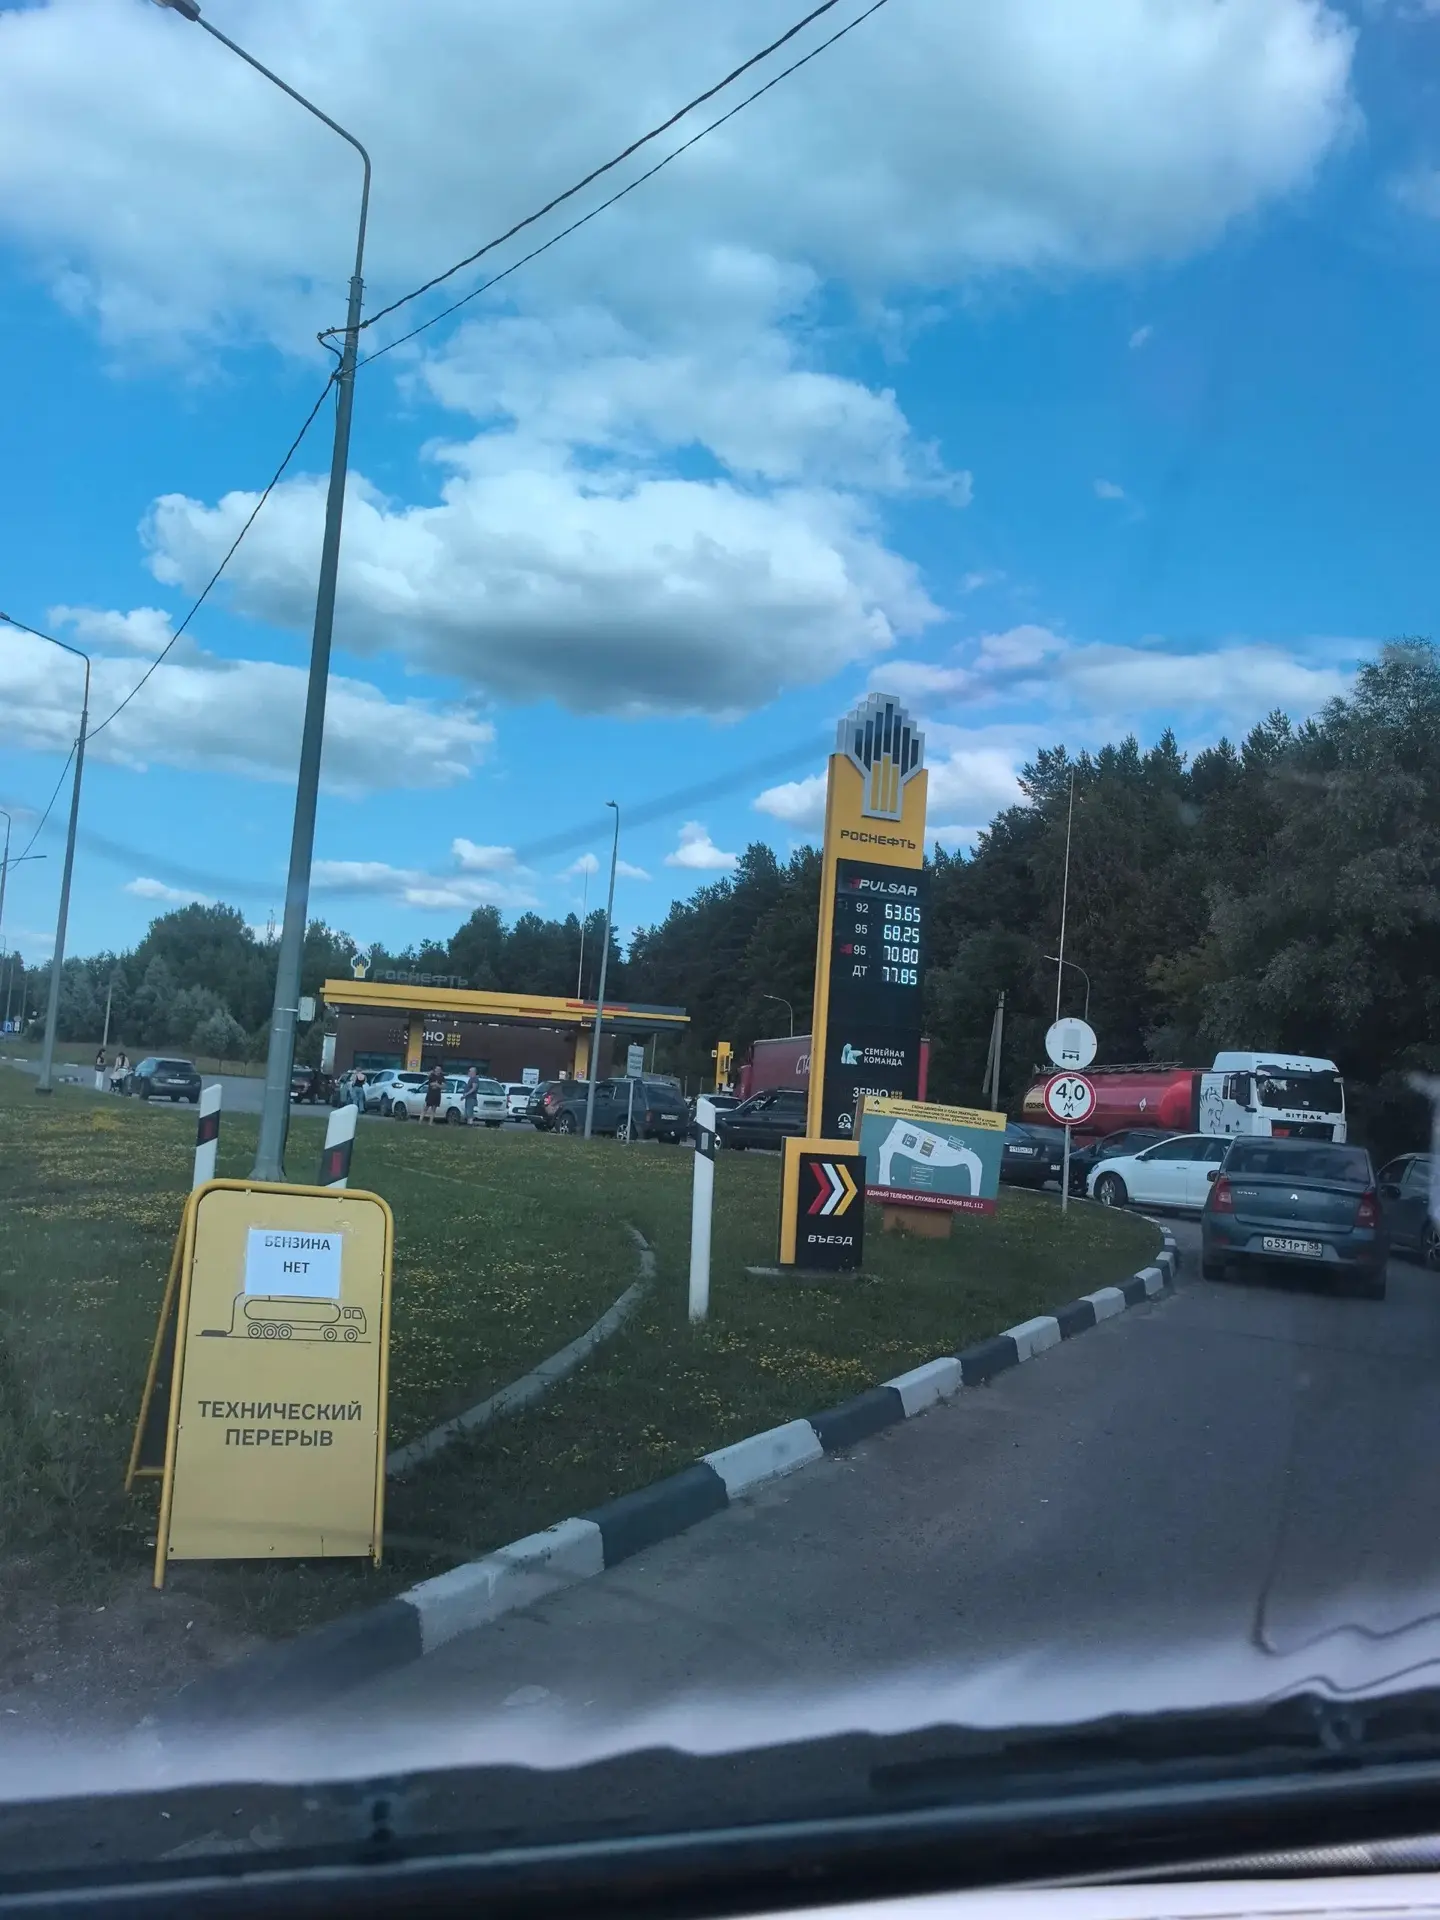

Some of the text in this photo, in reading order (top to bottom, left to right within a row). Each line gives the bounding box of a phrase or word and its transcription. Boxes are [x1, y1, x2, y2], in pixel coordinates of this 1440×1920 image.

[840, 829, 916, 850] РОСНЕФТЬ
[859, 879, 918, 897] PULSAR
[856, 902, 921, 923] 92 63.65
[855, 923, 920, 944] 95 68.25
[853, 944, 919, 965] 95 70.80
[374, 969, 469, 987] РОСНЕФТЬ
[852, 965, 917, 985] ДТ 77.85
[863, 1056, 903, 1067] КОМАНДА
[864, 1047, 905, 1058] СЕМЕЙНАЯ
[838, 1121, 852, 1129] 24
[1285, 1112, 1322, 1121] SITRAK
[867, 1189, 889, 1198] ЕДИНЫЙ
[889, 1192, 914, 1201] ТЕЛЕФОН
[914, 1195, 936, 1203] СЛУЖБЫ
[936, 1198, 962, 1206] СПАСЕНИЯ
[264, 1235, 331, 1251] БЕНЗИНА
[807, 1234, 853, 1246] ВЪЕЗД
[283, 1261, 310, 1274] НЕТ
[198, 1400, 362, 1421] ТЕХНИЧЕСКИЙ
[225, 1428, 334, 1447] ПЕРЕРЫВ
